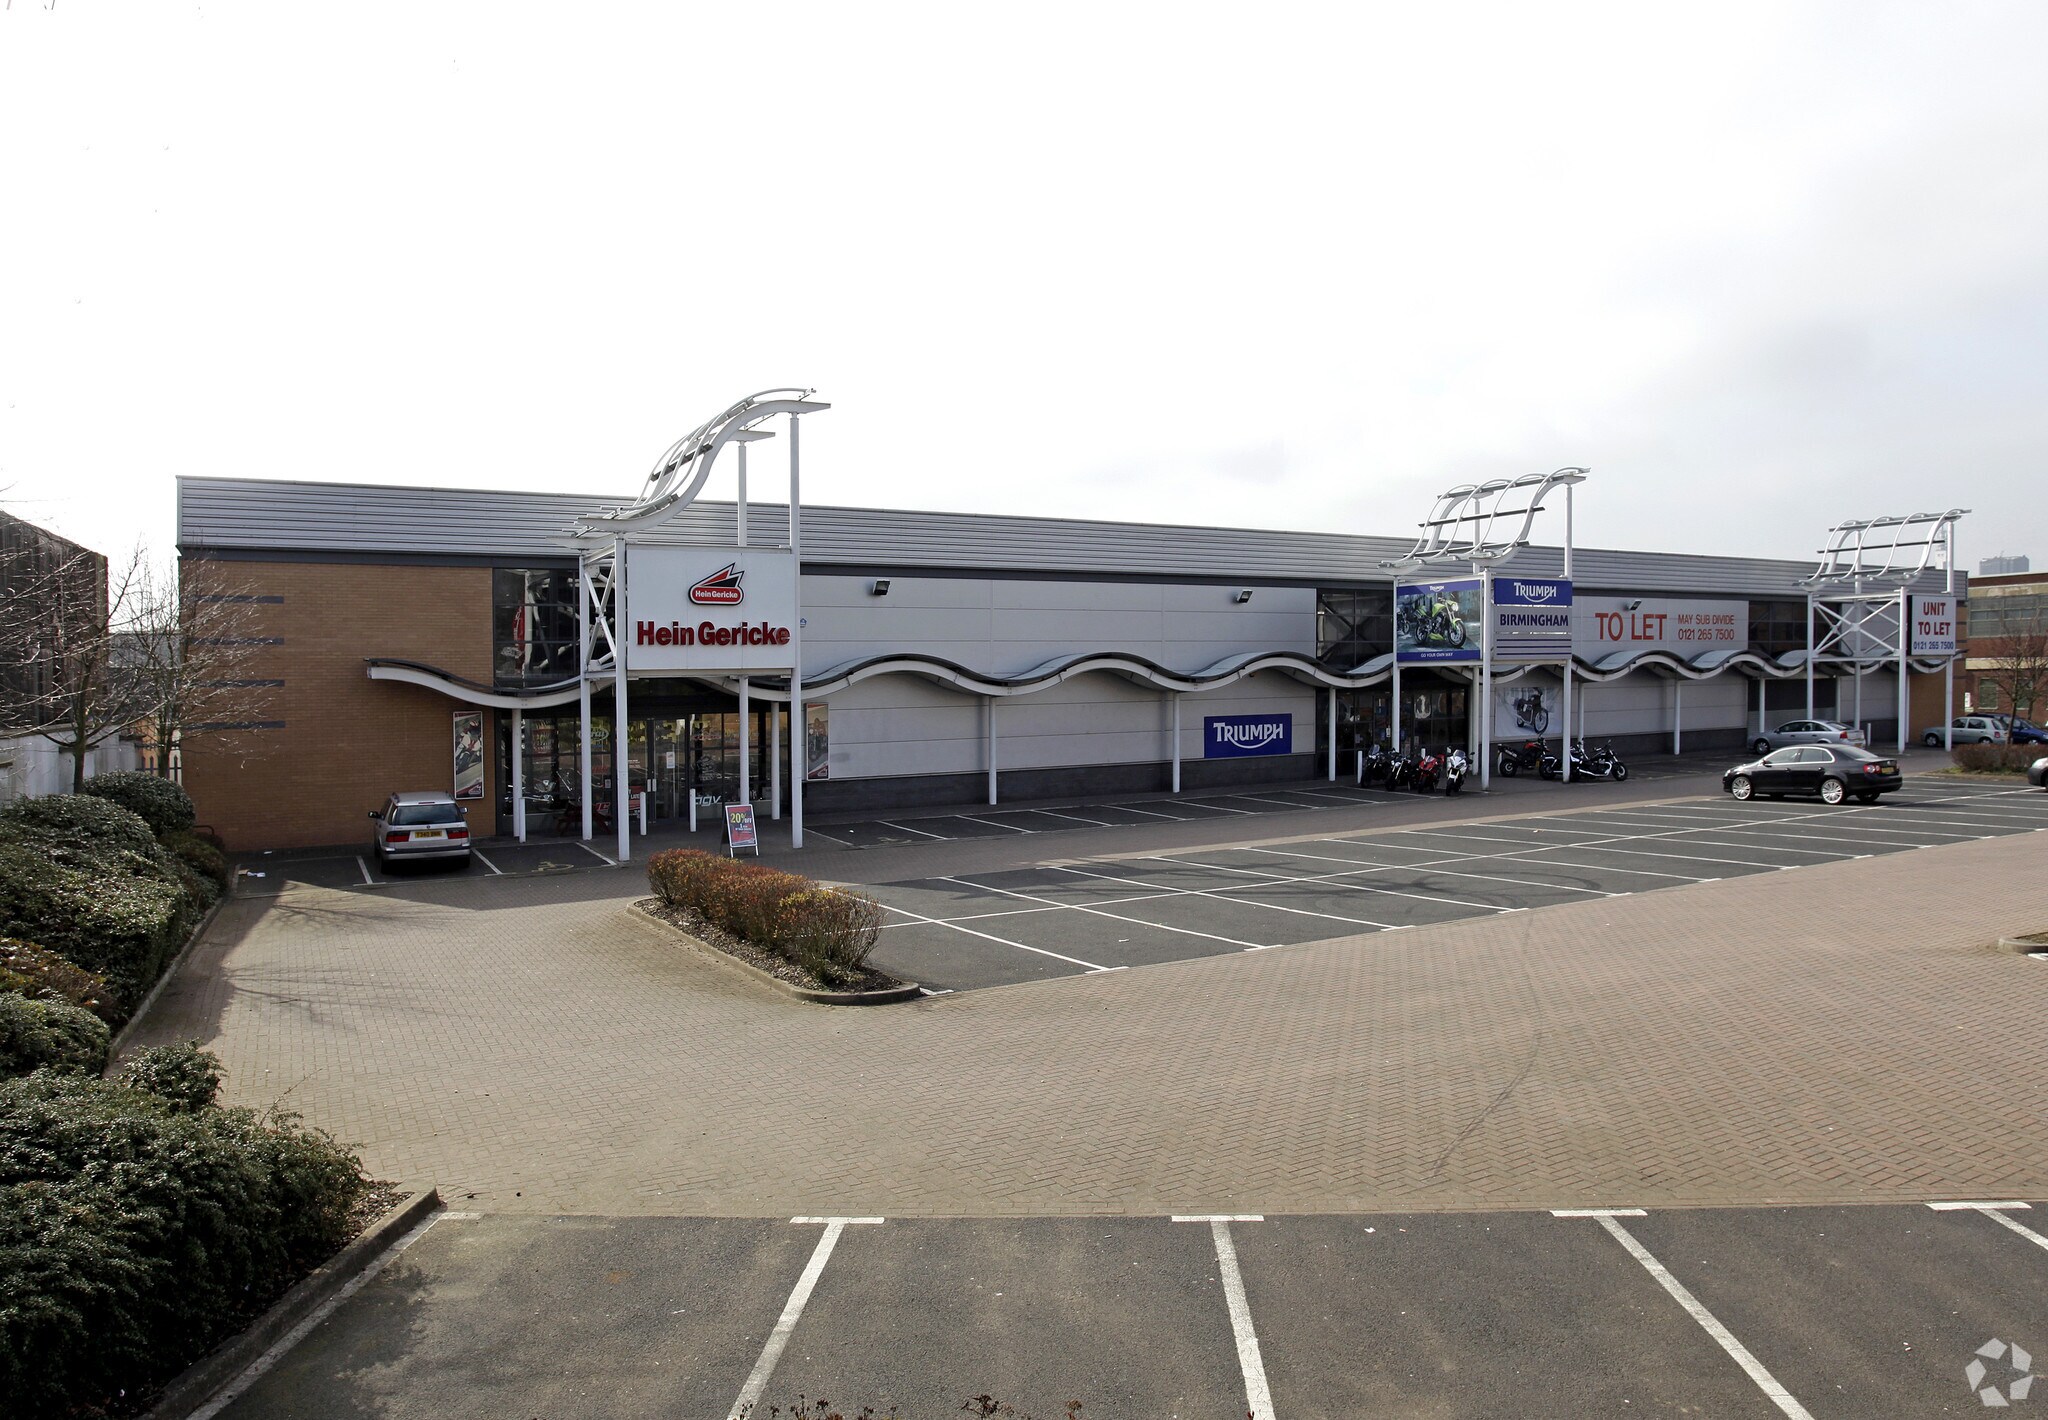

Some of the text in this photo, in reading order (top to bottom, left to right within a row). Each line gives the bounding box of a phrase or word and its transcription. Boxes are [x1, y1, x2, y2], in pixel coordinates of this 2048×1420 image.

[712, 590, 738, 598] Gericke
[1513, 582, 1557, 602] TRIUMPH
[1923, 602, 1946, 616] UNIT
[1499, 614, 1569, 627] BIRMINGHAM
[1678, 614, 1735, 625] MAY SUB DIVIDE
[637, 620, 791, 646] Hein Gericke
[1594, 612, 1667, 641] TO LET
[1918, 622, 1951, 635] TO LET
[1678, 629, 1735, 640] 0121 265 7500
[1913, 641, 1954, 650] 0121 265 7500
[1213, 722, 1284, 749] TRIUMPH
[730, 813, 747, 824] 20%
